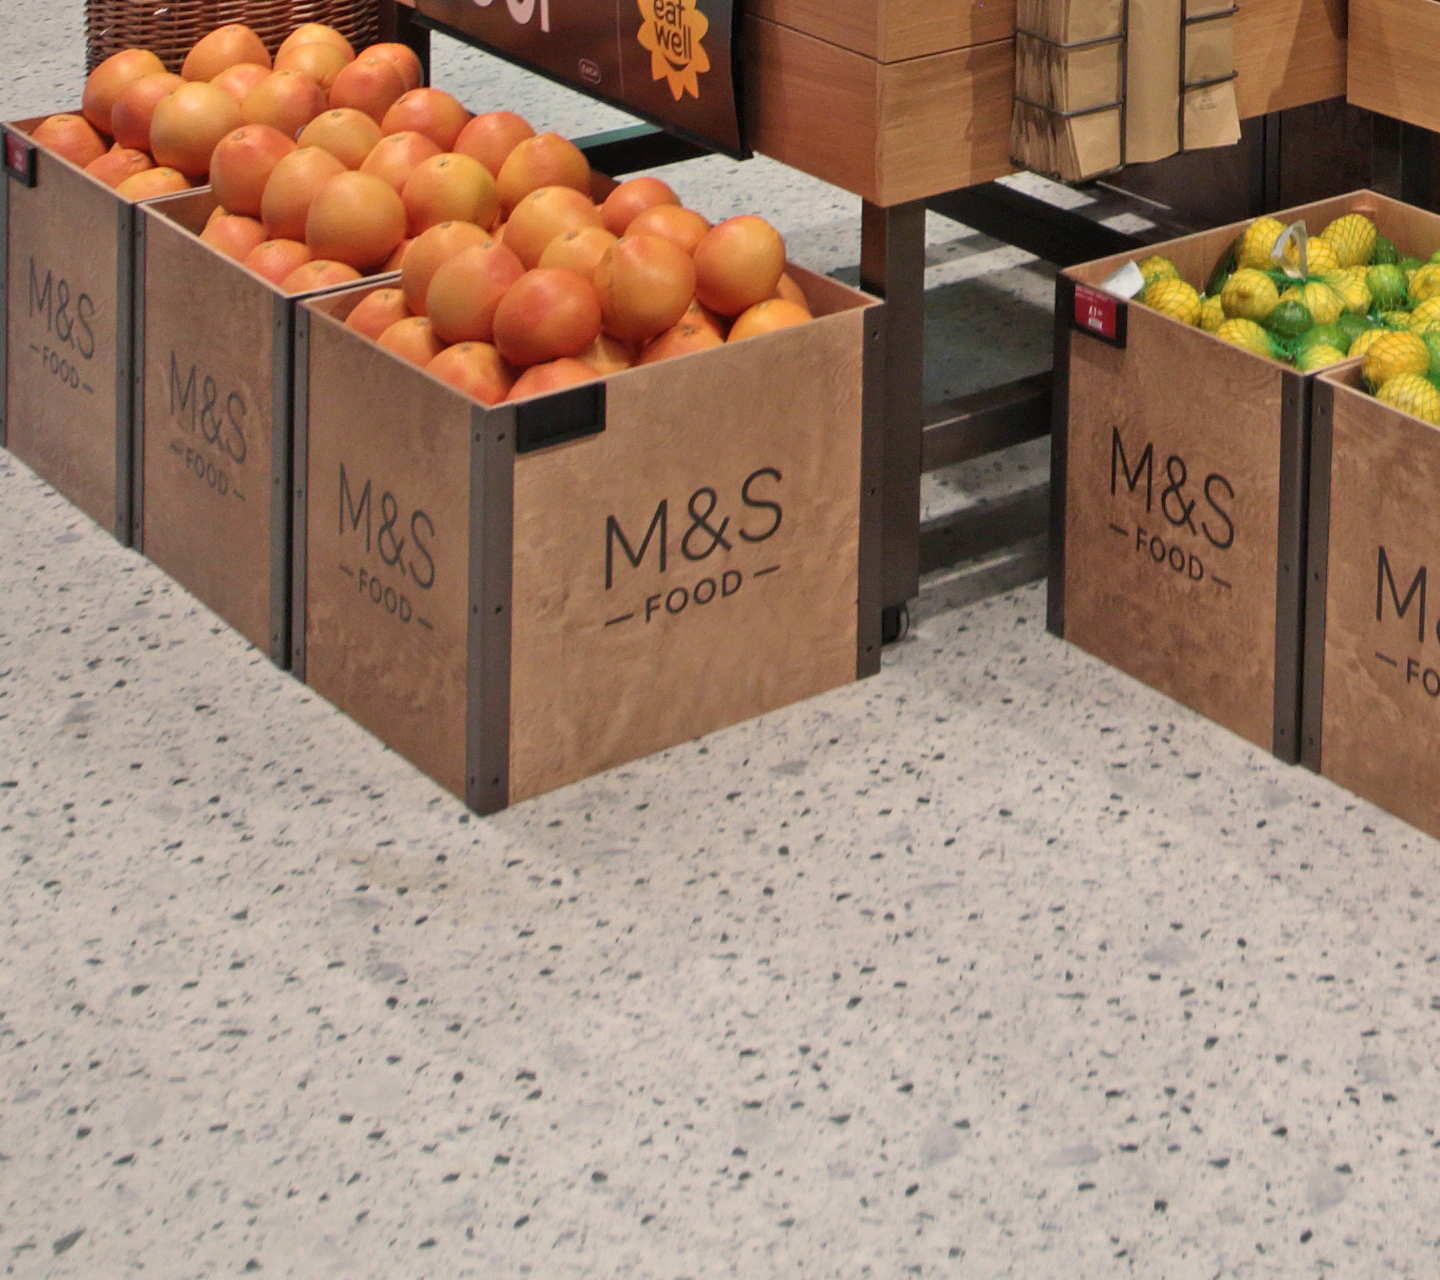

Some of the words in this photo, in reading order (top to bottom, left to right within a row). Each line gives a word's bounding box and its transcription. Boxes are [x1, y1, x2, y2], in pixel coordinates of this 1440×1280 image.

[653, 21, 693, 60] well
[28, 256, 95, 361] M&S
[42, 345, 80, 390] FOOD
[168, 349, 248, 465] M&S
[185, 445, 229, 497] FOOD
[1110, 425, 1236, 551] M&S
[338, 461, 435, 590] M&S
[604, 466, 784, 591] M&S
[1136, 526, 1204, 582] FOOD
[359, 567, 413, 624] FOOD
[644, 568, 743, 624] FOOD
